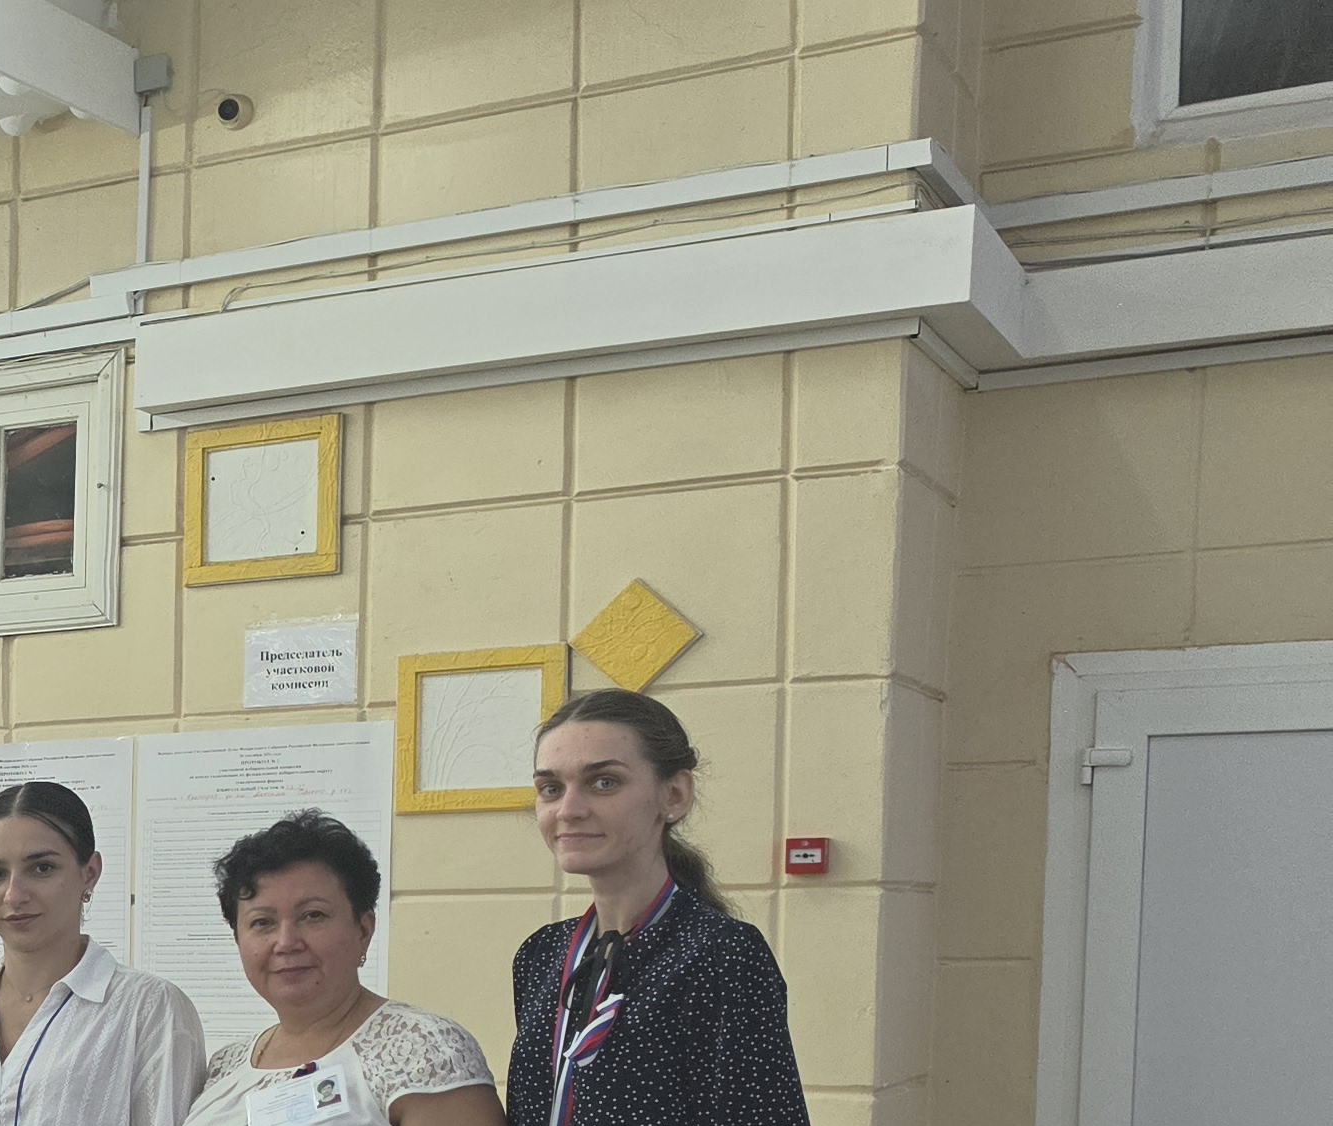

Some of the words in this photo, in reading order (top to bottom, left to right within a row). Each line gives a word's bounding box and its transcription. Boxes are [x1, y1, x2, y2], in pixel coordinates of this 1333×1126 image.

[260, 648, 343, 663] Председатель
[265, 662, 335, 679] участковой
[271, 680, 329, 691] комиссии
